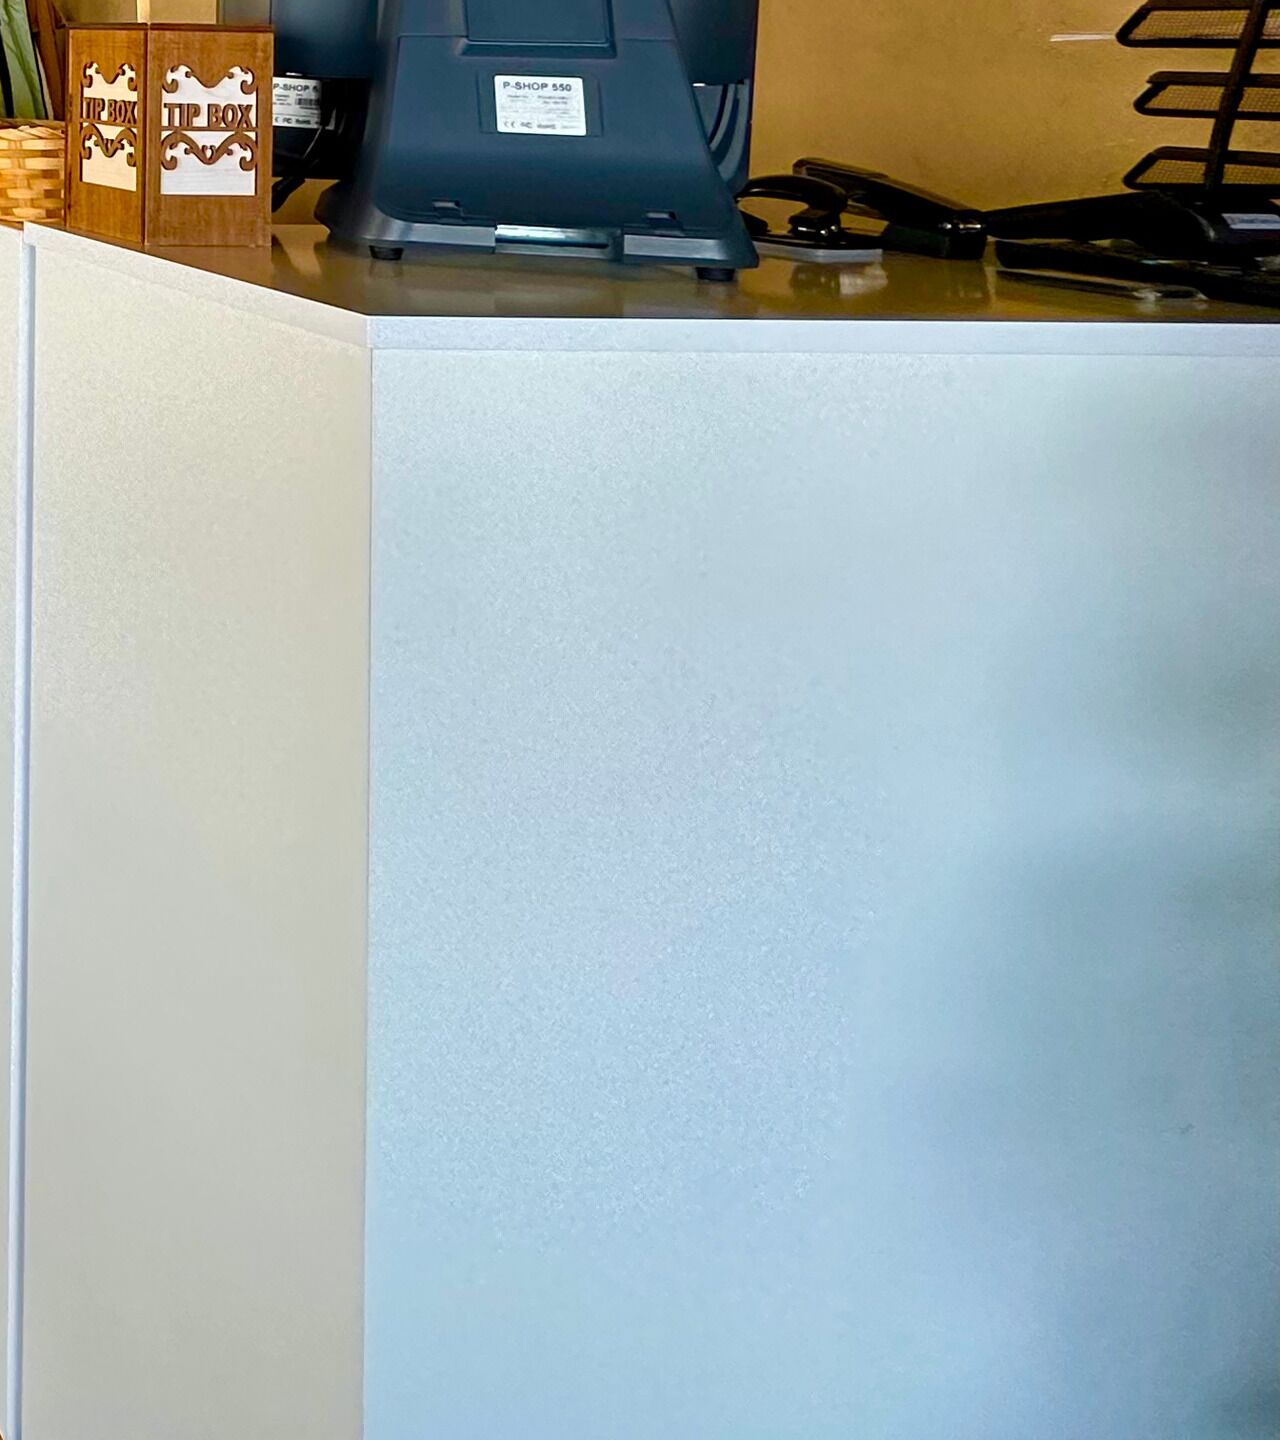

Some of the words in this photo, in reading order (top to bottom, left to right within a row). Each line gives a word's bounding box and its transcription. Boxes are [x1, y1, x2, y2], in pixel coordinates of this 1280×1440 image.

[503, 81, 548, 91] P-SHOP
[551, 83, 572, 92] 550
[84, 97, 106, 121] TIP
[107, 99, 138, 124] BOX
[163, 103, 201, 128] TIP
[207, 103, 254, 129] BOX
